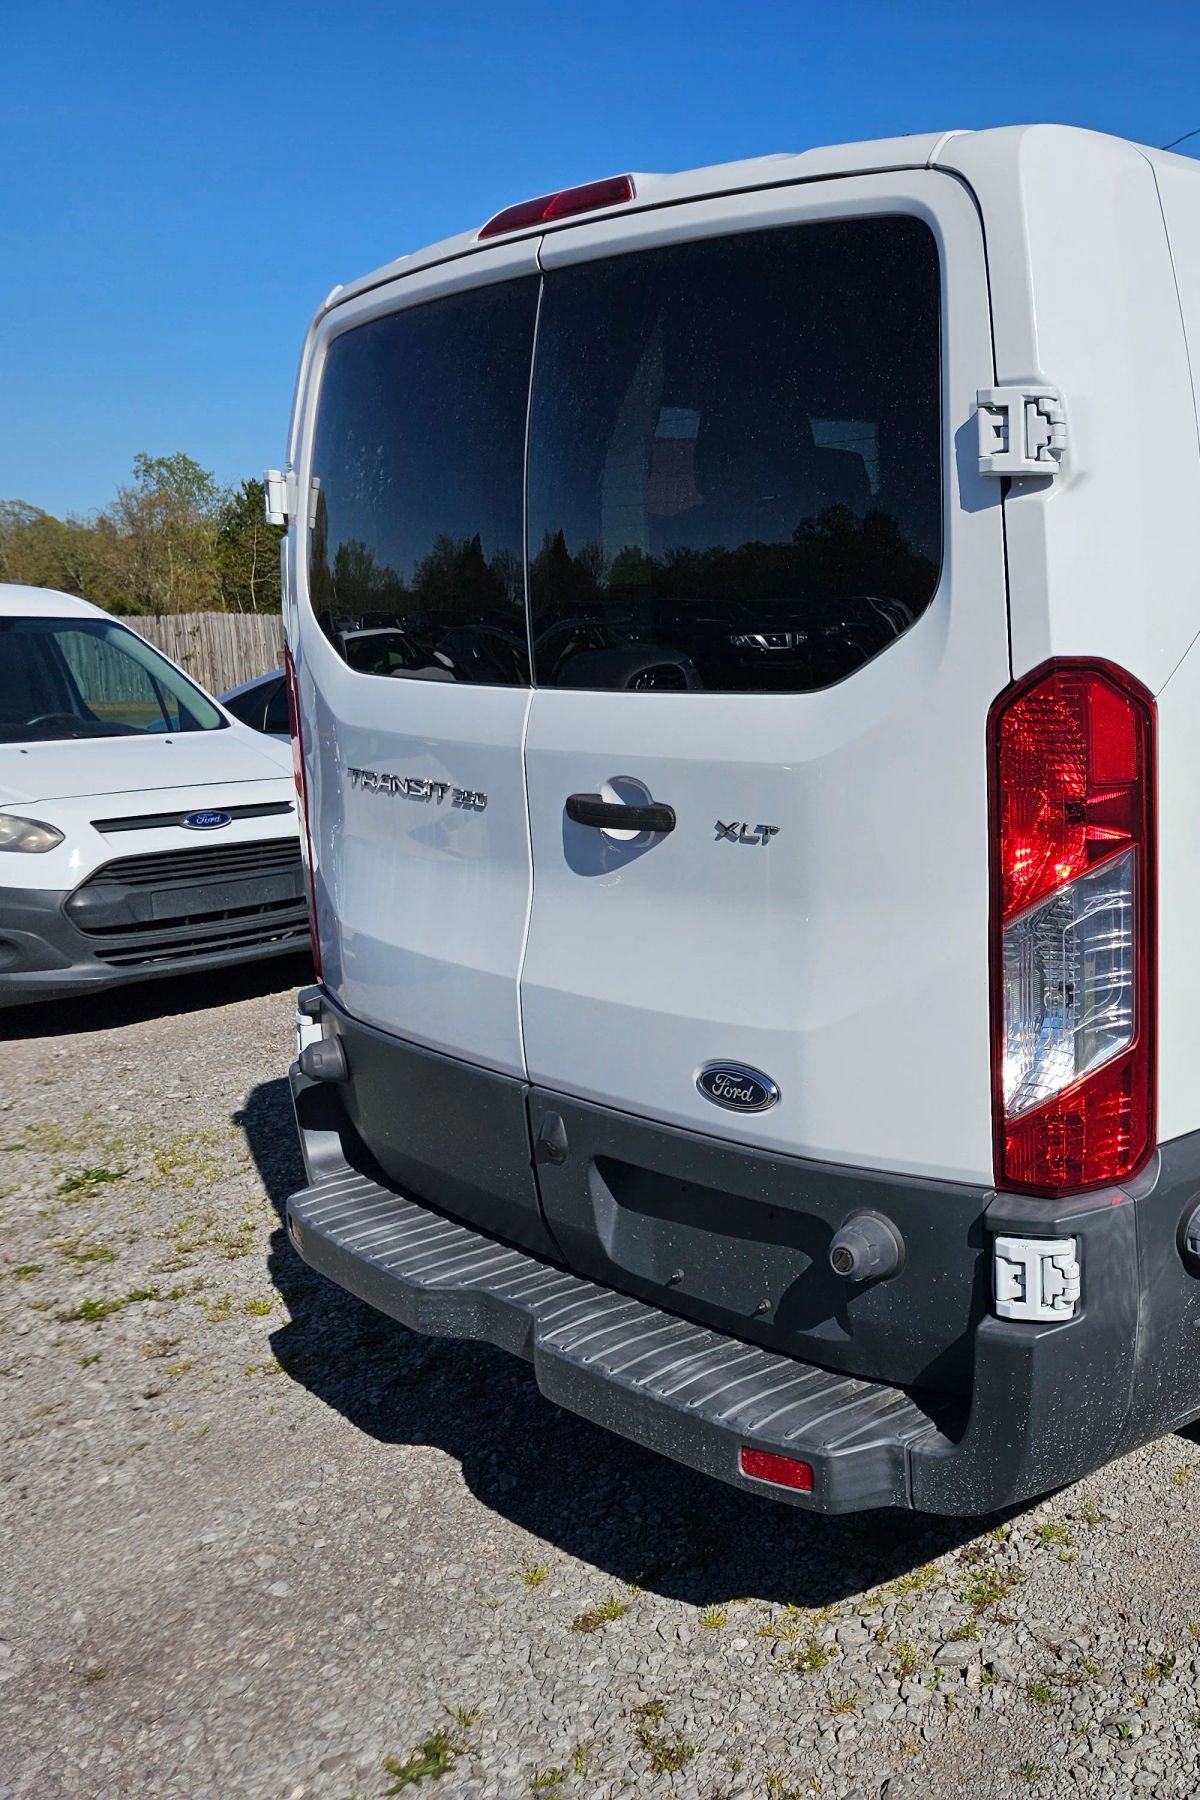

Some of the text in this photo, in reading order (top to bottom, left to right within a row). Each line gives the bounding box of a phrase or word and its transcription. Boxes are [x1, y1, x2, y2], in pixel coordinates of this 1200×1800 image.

[347, 767, 451, 803] TRANSIT
[196, 813, 221, 824] Ford
[714, 820, 780, 846] XLT
[711, 1073, 754, 1102] Ford
